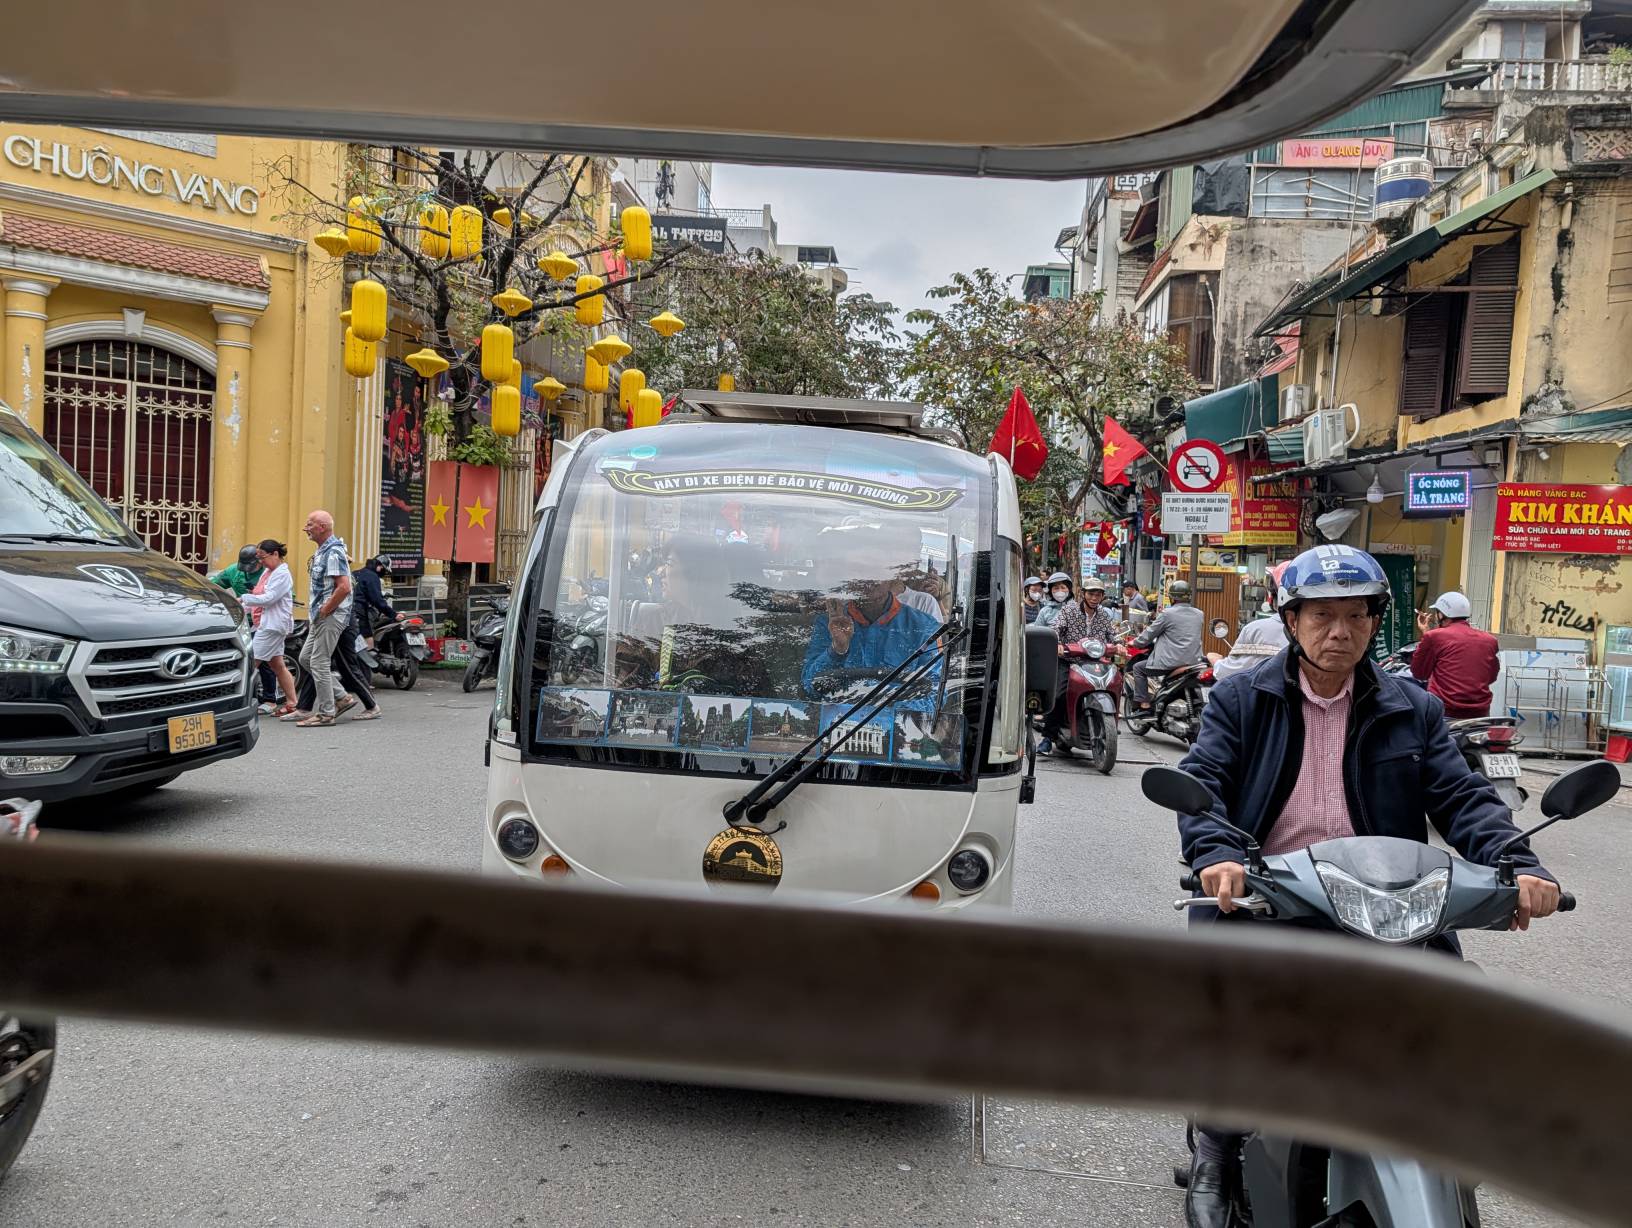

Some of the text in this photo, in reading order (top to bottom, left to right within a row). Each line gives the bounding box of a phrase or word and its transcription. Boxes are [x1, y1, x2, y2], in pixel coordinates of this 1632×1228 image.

[1322, 144, 1361, 158] QUANG
[4, 134, 164, 195] CHUÔNG
[671, 227, 723, 243] TATTOO
[685, 477, 699, 487] ĐI
[703, 476, 719, 486] XE
[723, 475, 754, 487] ĐIỆN
[828, 481, 853, 493] MÔI
[857, 485, 909, 504] TRƯỜNG
[1418, 477, 1431, 488] ỐC
[1413, 491, 1465, 504] HÀ TRANG
[1497, 487, 1587, 499] CỬA HÀNG VÀNG BẠC
[1508, 498, 1632, 525] KIM KHÁN
[1508, 525, 1524, 533] SỬA
[1527, 526, 1548, 535] CHỮA
[1320, 560, 1340, 571] ta
[182, 716, 203, 733] 29H
[175, 730, 212, 750] 953.05
